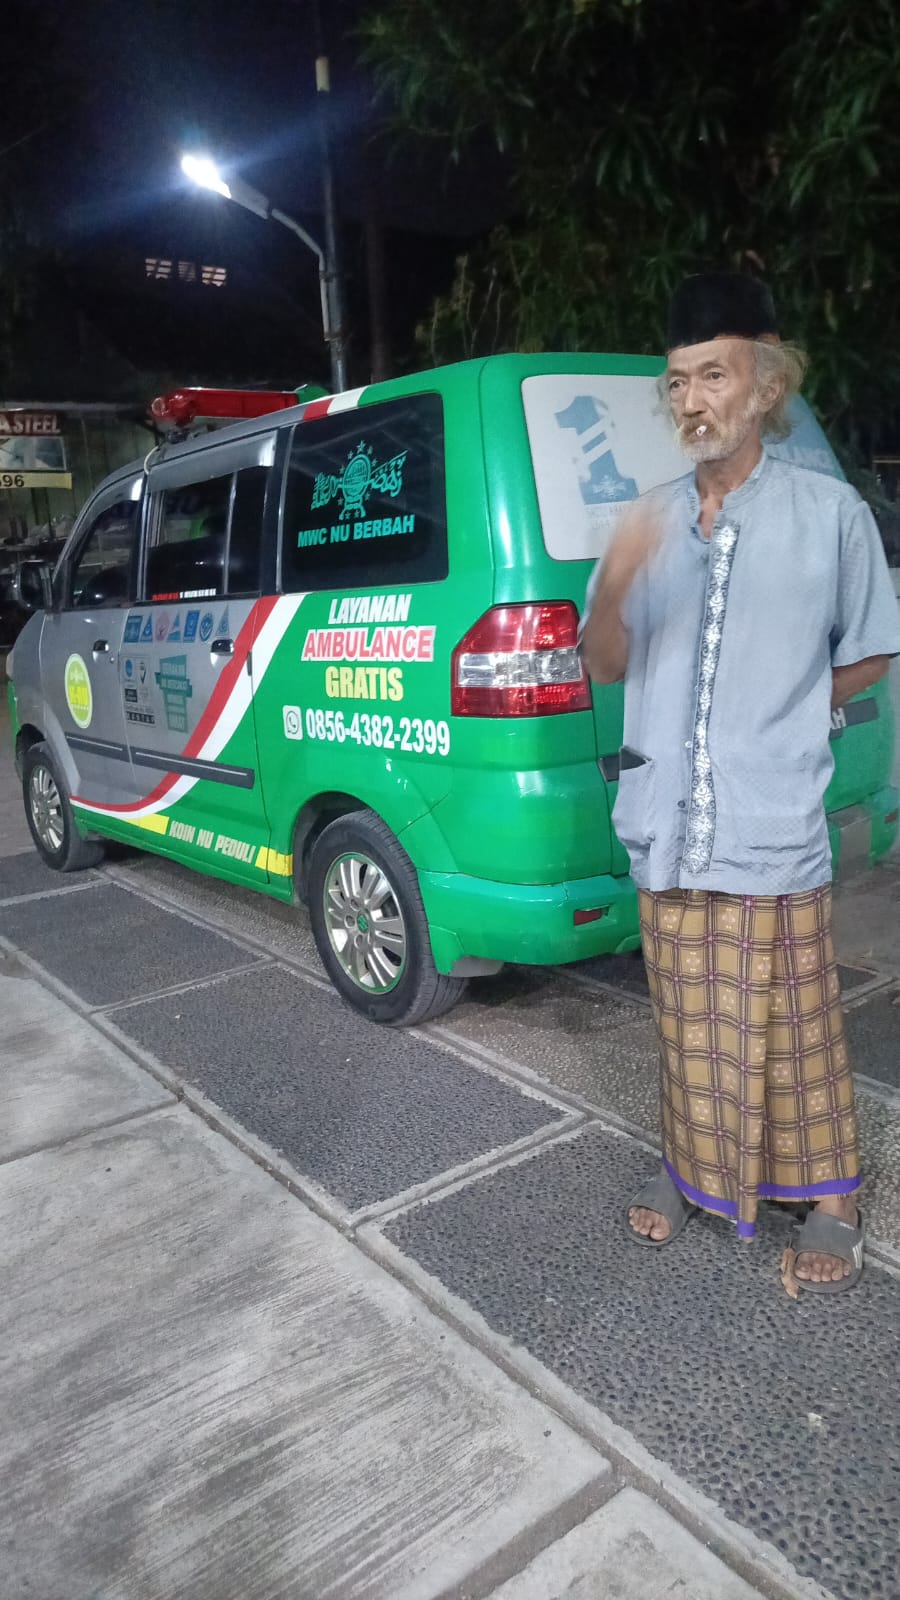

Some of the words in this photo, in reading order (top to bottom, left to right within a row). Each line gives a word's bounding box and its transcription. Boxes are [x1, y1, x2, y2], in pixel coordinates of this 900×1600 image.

[12, 414, 61, 433] STEEL
[297, 529, 327, 548] MWC
[330, 525, 350, 544] NU
[353, 514, 415, 541] BERBAH
[328, 594, 412, 625] LAYANAN
[302, 626, 436, 662] AMBULANCE
[325, 666, 404, 702] GRATIS
[305, 708, 451, 756] 0856-4382-2399
[168, 820, 196, 843] KOIN
[196, 828, 215, 849] NU
[214, 834, 257, 864] PEDULI
